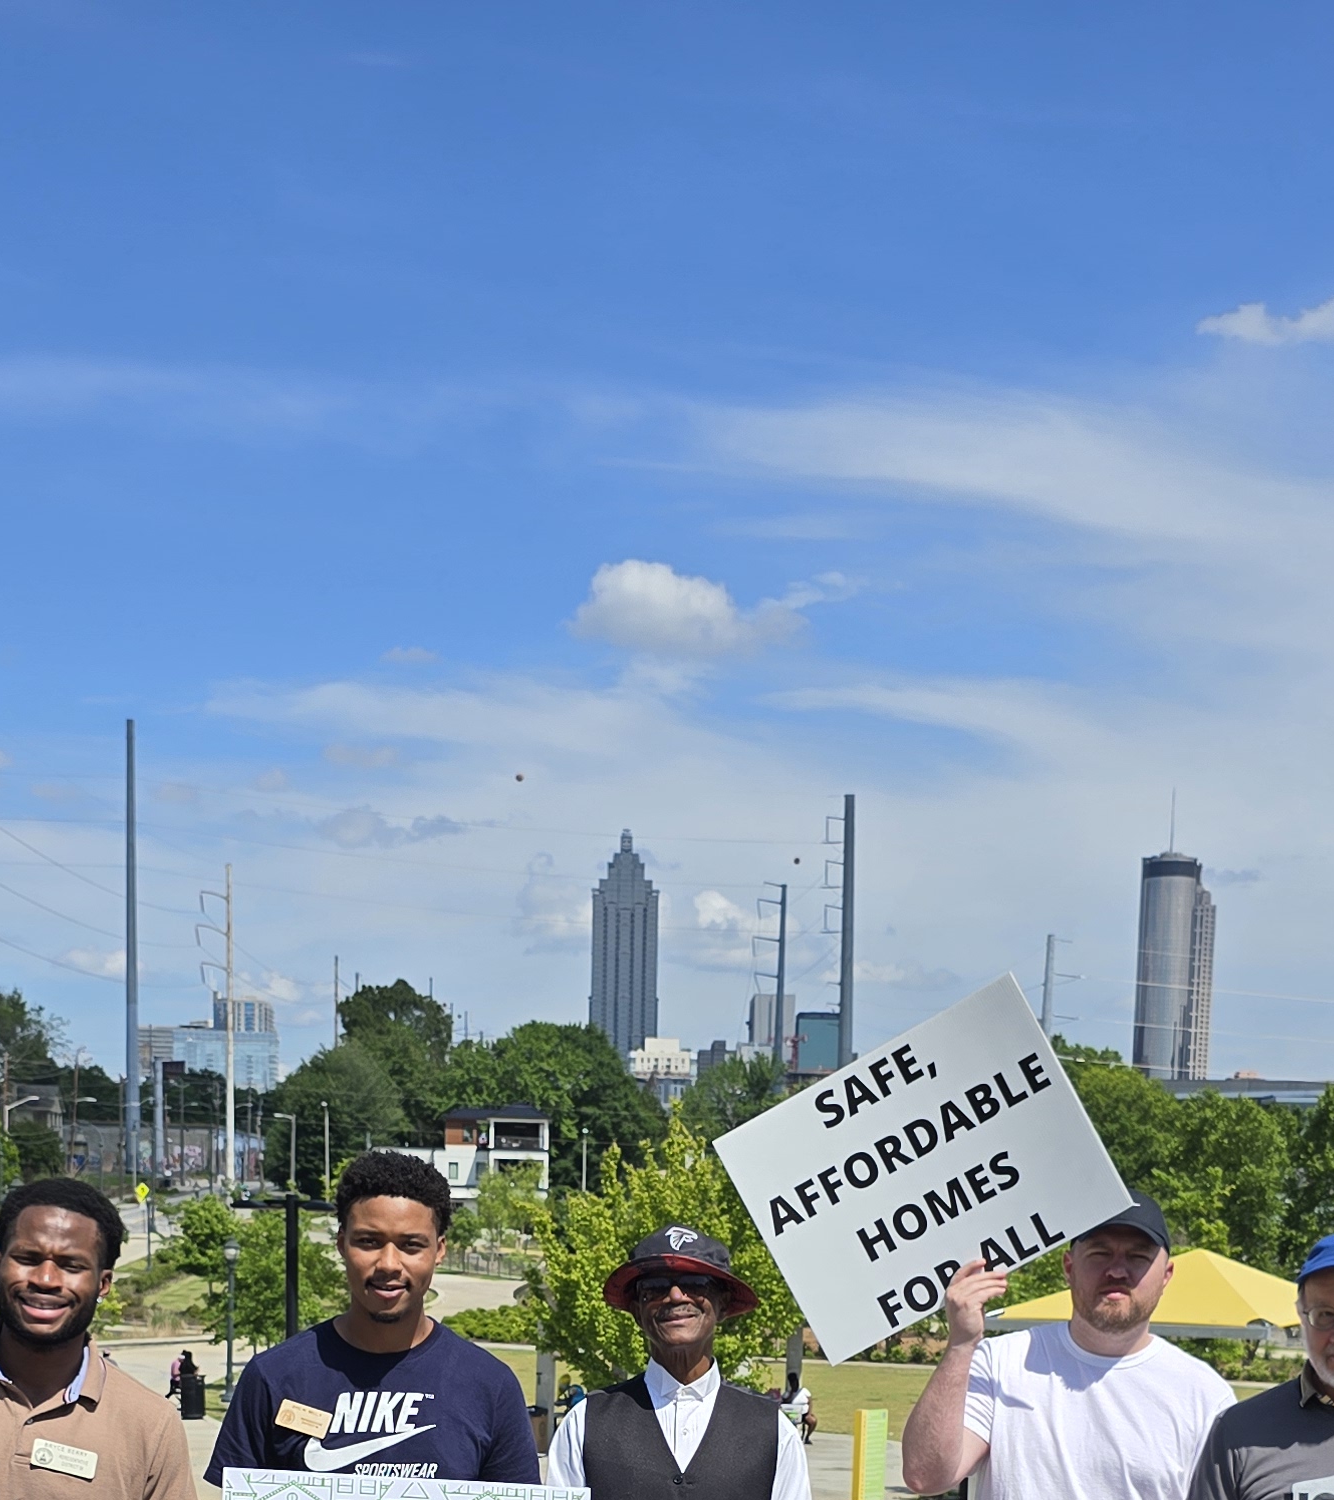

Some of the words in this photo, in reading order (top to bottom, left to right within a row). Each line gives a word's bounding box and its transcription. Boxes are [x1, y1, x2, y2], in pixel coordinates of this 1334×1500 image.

[815, 1044, 937, 1128] SAFE,
[769, 1052, 1051, 1236] AFFORDABLE
[856, 1150, 1020, 1262] HOMES
[979, 1212, 1065, 1272] ALL
[329, 1392, 425, 1433] NIKE
[353, 1463, 438, 1478] SPORTSWEAR
